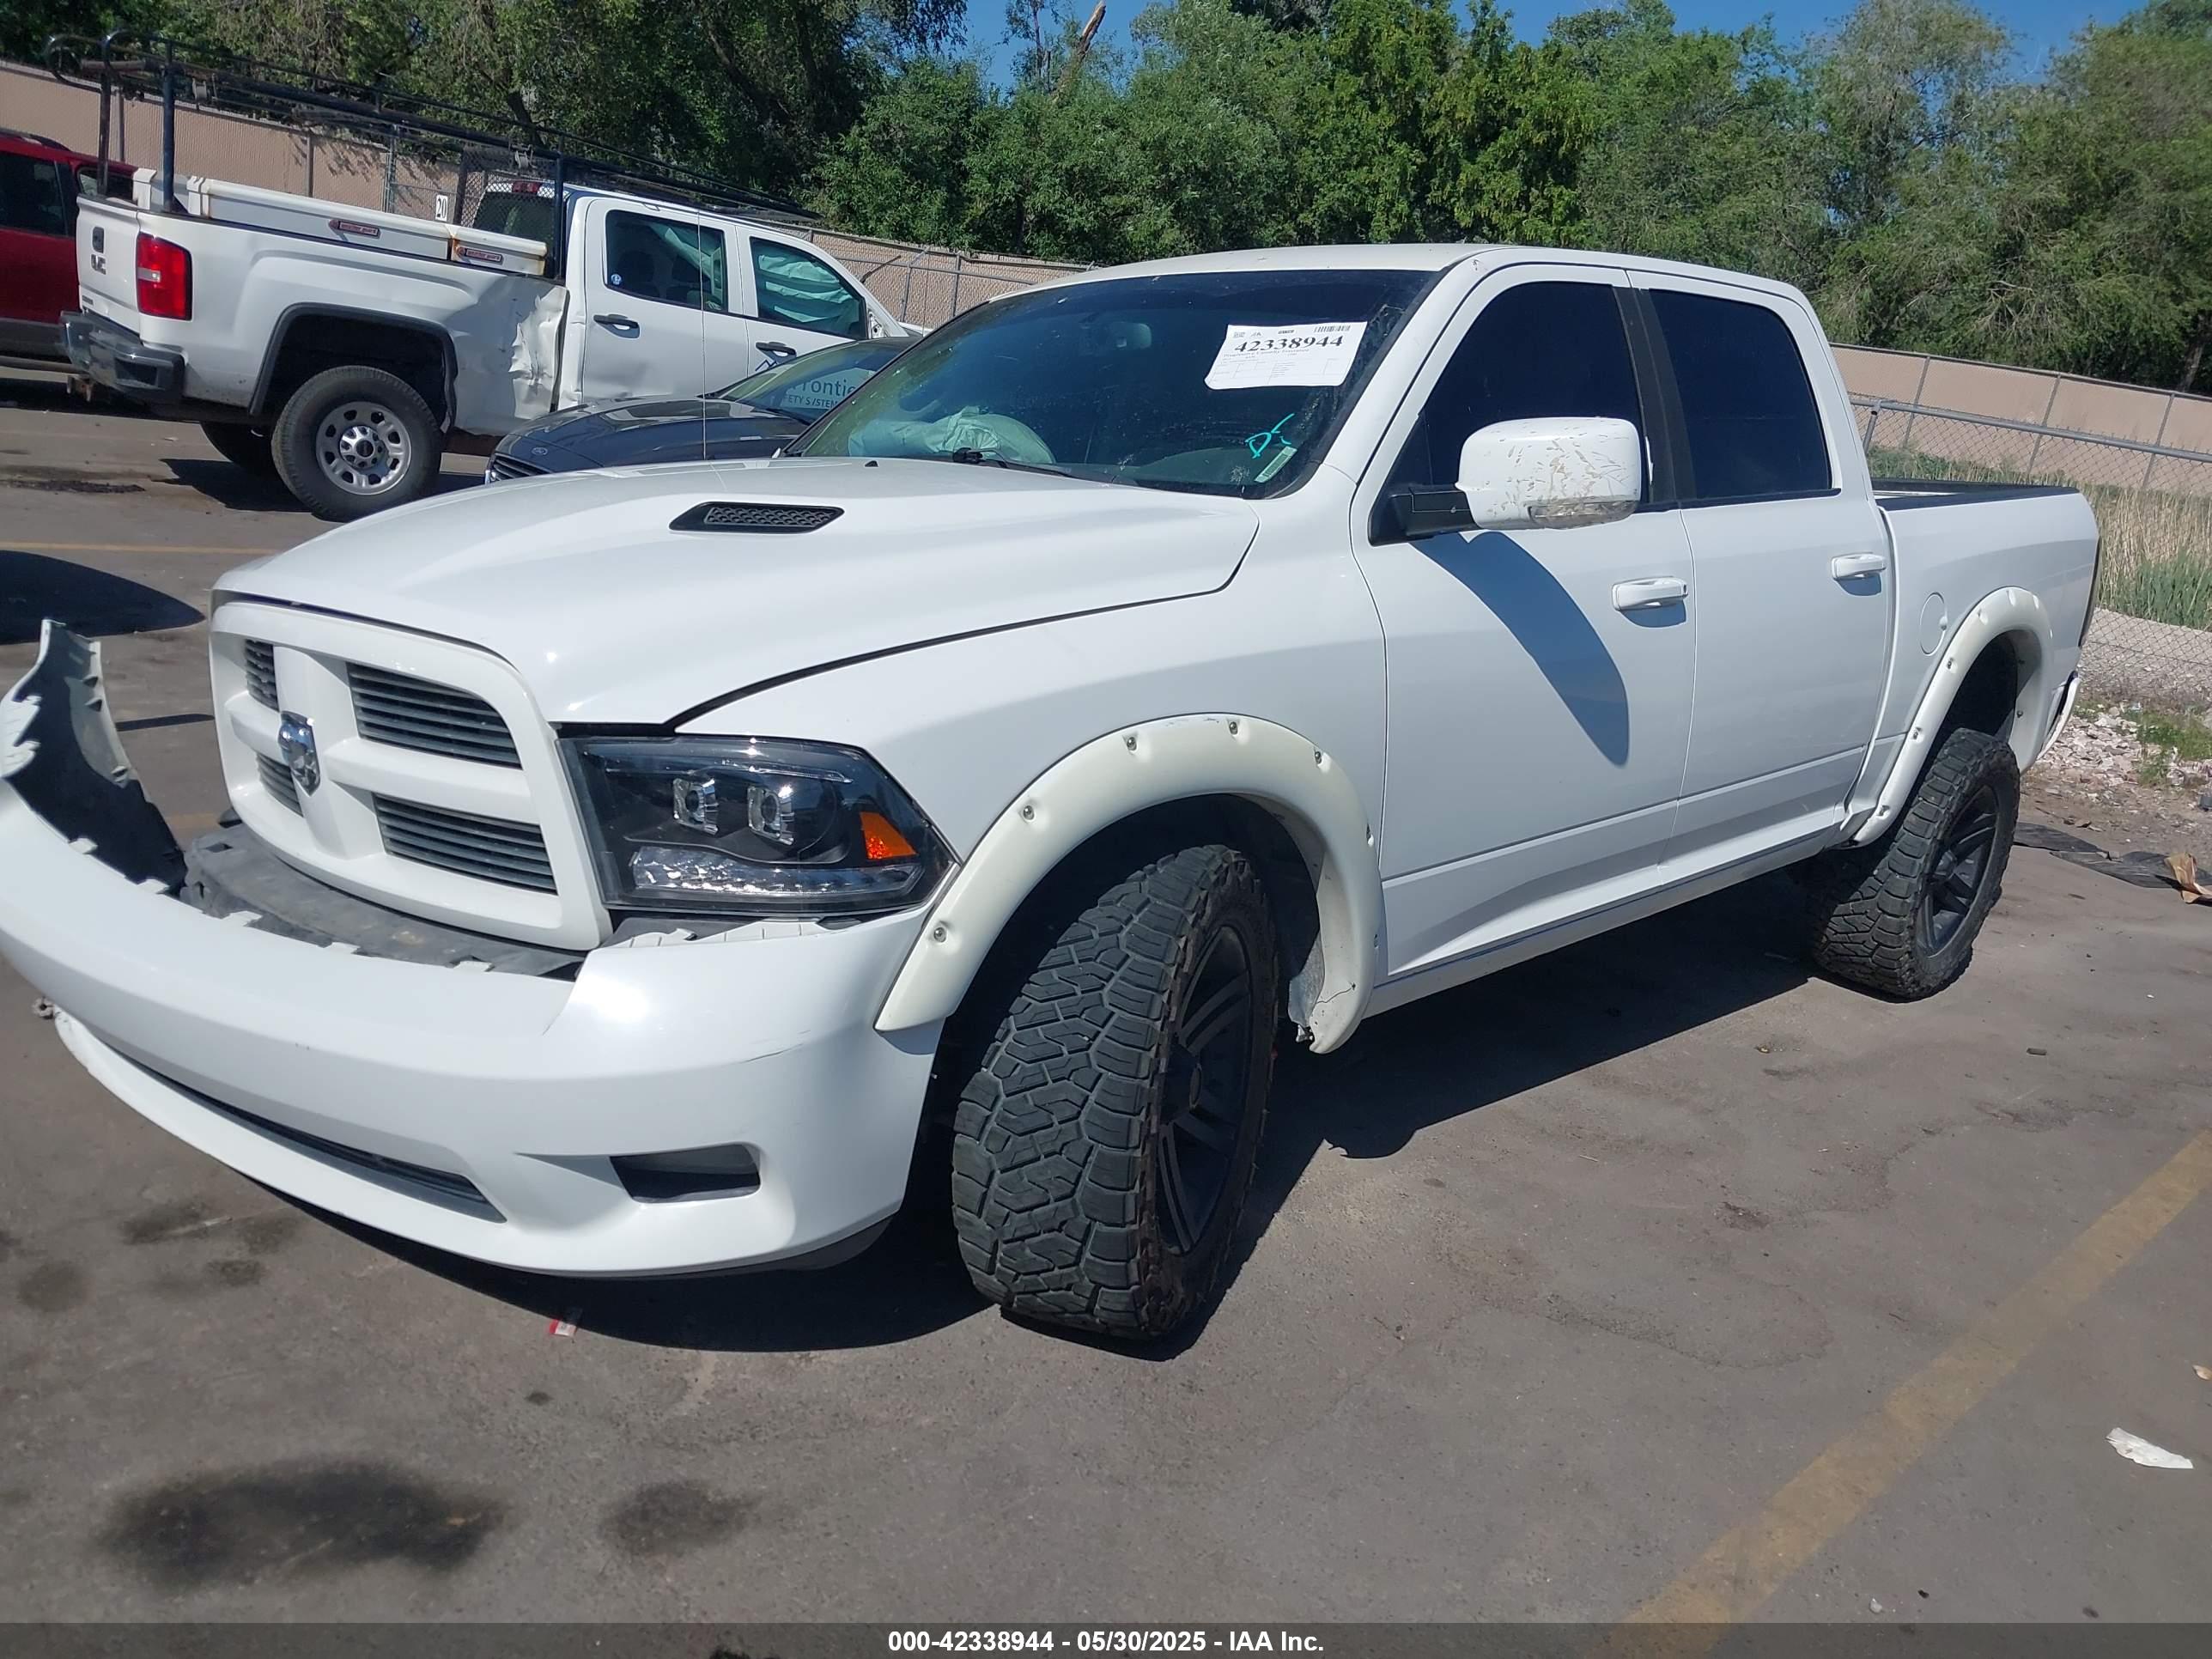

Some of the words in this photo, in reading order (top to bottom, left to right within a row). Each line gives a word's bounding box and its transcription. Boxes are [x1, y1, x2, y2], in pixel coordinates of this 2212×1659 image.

[436, 197, 447, 219] 20
[1235, 335, 1344, 353] 42338944
[793, 379, 856, 397] rontie
[785, 394, 804, 405] ETY
